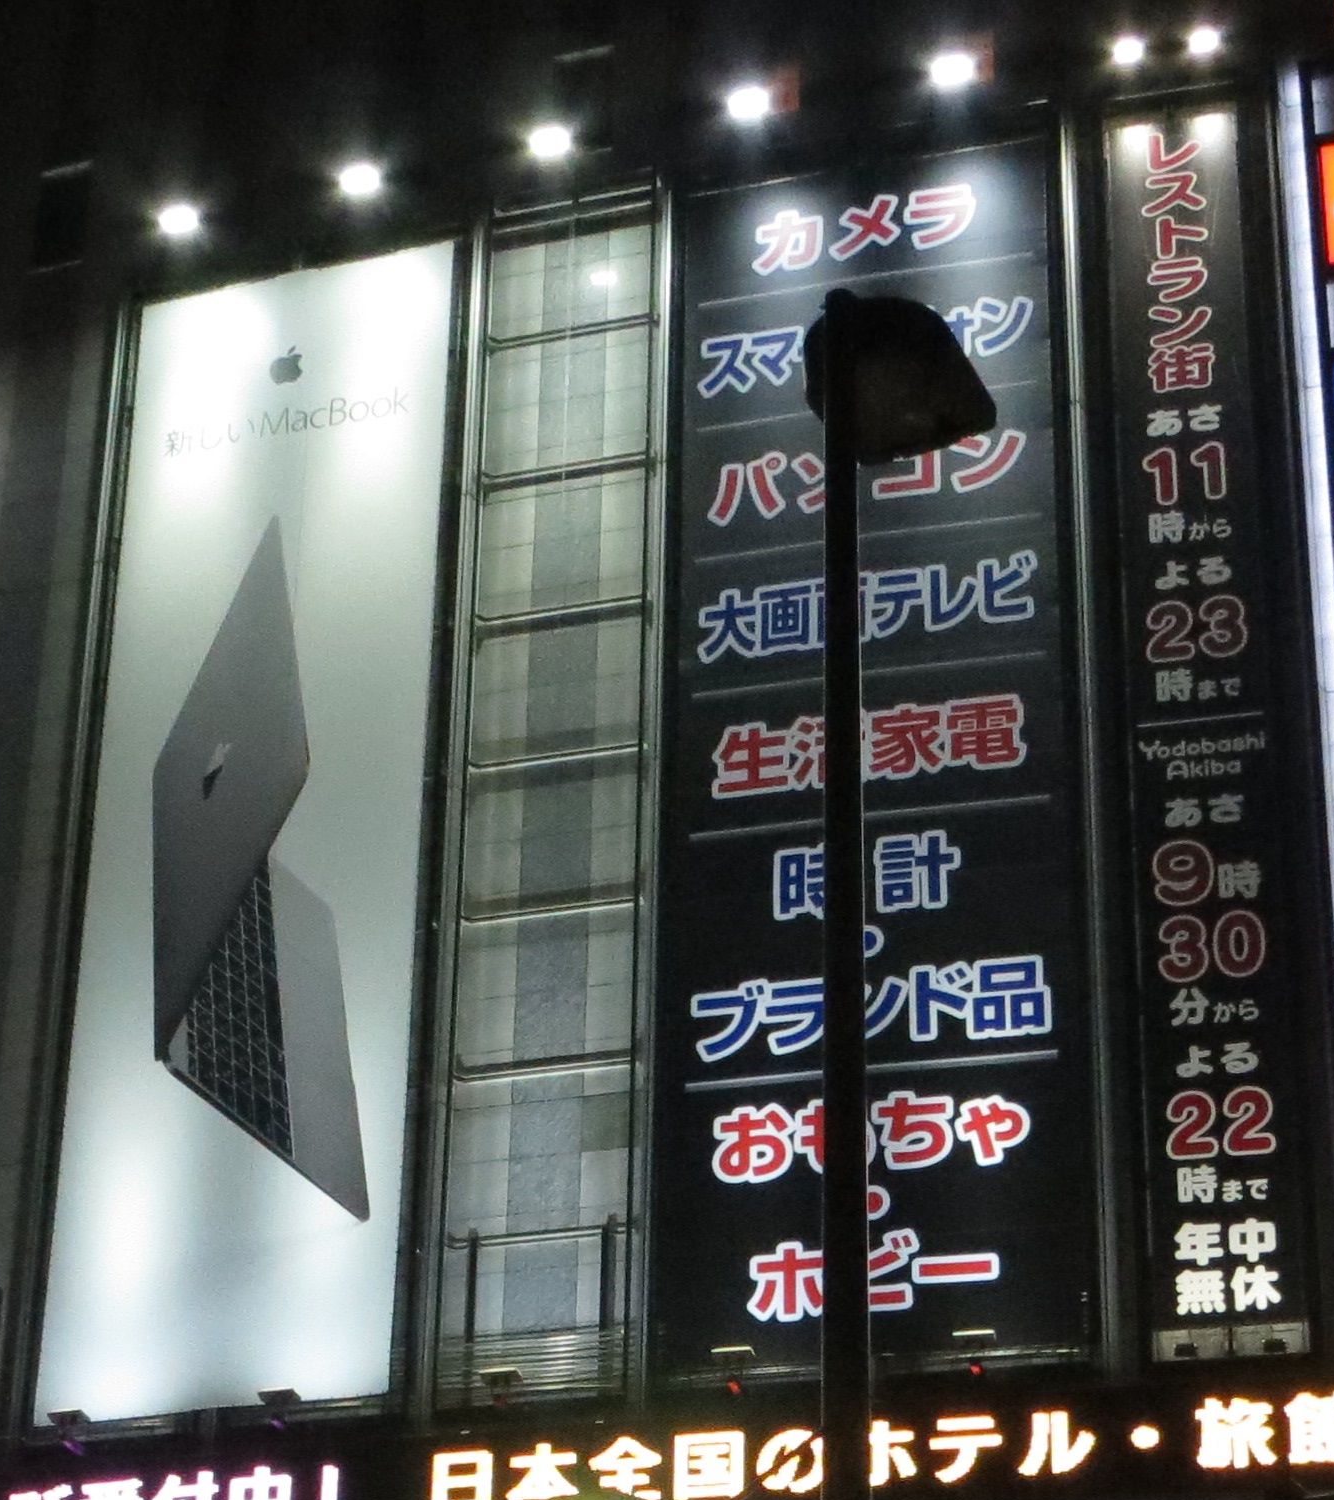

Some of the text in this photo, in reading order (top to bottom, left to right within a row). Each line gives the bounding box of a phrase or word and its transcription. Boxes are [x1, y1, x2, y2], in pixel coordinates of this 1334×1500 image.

[752, 184, 975, 275] カメラ
[1141, 132, 1215, 394] レストラン街
[1147, 403, 1223, 437] あさ
[1142, 441, 1227, 506] 11
[1148, 511, 1233, 545] 時から
[1155, 555, 1233, 591] よる
[697, 550, 1037, 664] 大画テレビ
[1145, 594, 1249, 664] 23
[1155, 668, 1242, 702] 時まで
[1138, 731, 1266, 761] Yodobashi
[1167, 759, 1242, 781] Akiba
[1165, 794, 1245, 828] あさ
[1152, 839, 1263, 907] 9時
[1157, 909, 1267, 984] 30
[1170, 988, 1261, 1028] 分から
[1175, 1041, 1260, 1079] よる
[1165, 1085, 1277, 1160] 22
[1175, 1165, 1269, 1203] 時まで
[1174, 1217, 1277, 1266] 年中
[747, 1230, 1000, 1323] ホビー
[1176, 1266, 1282, 1316] 無休
